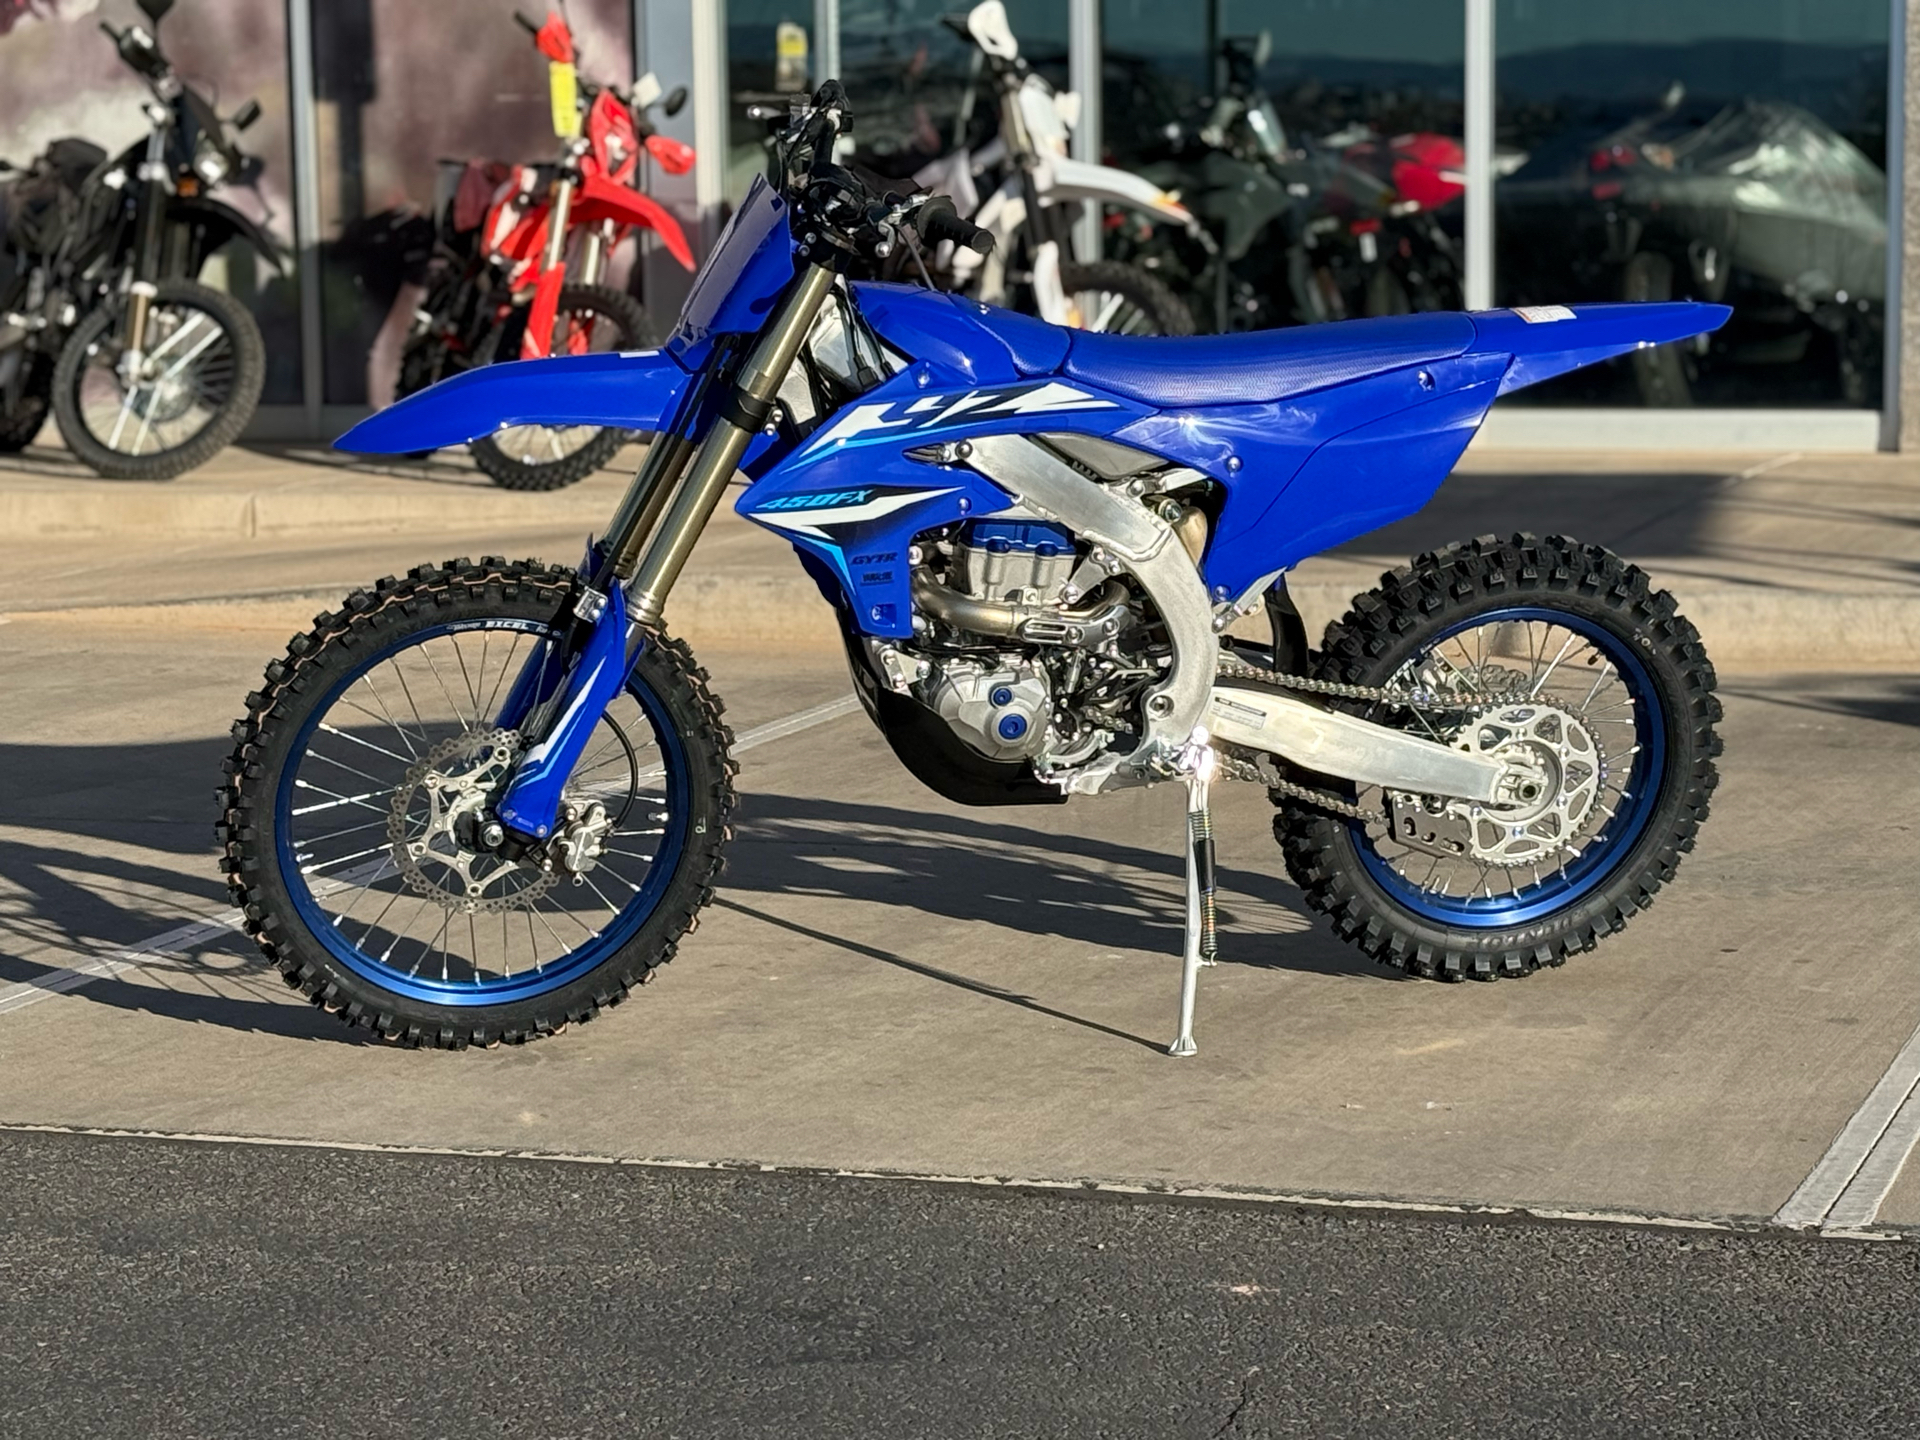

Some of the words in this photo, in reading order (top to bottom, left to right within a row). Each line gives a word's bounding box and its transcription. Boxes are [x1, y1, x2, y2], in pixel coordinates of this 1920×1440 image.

[755, 489, 875, 510] 450FX
[850, 552, 899, 565] GYTR
[484, 620, 530, 631] EXCEL
